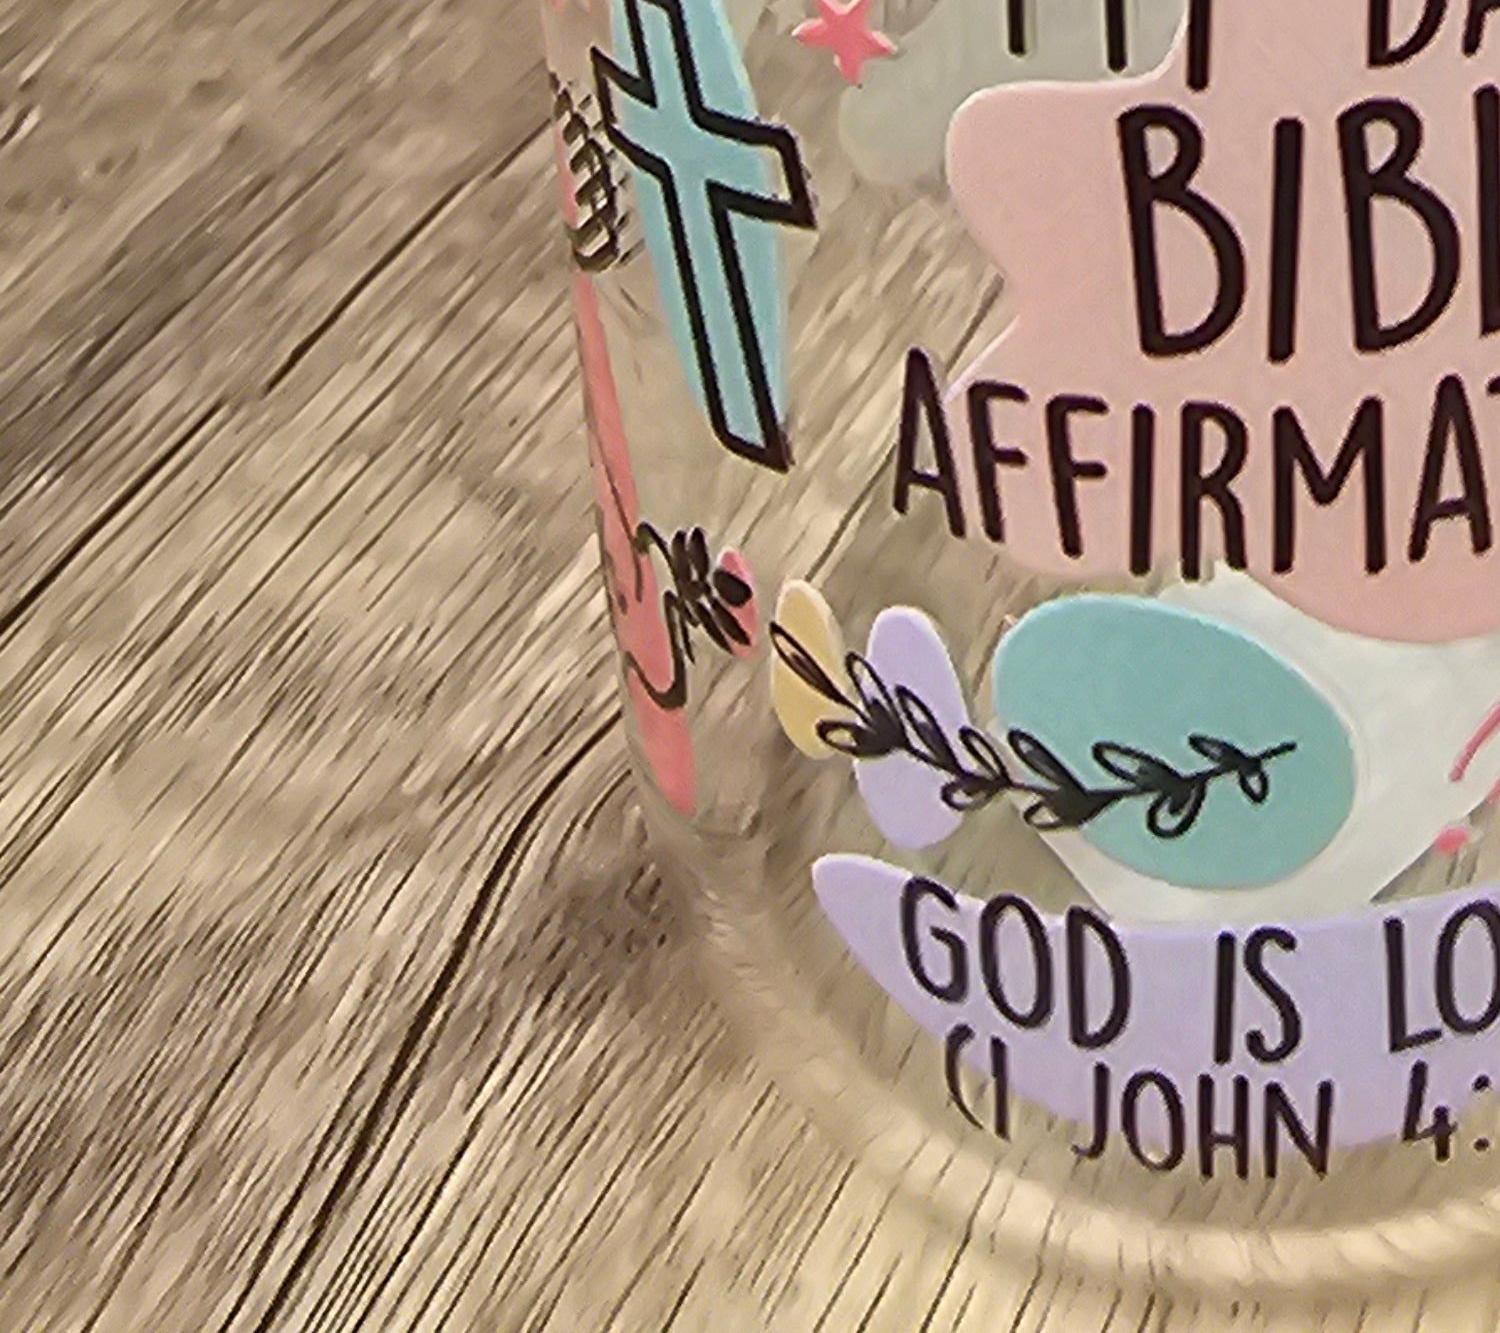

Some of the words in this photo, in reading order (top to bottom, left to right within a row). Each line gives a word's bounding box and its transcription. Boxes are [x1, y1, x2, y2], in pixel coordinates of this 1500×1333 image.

[899, 875, 1132, 1050] GOD
[1213, 927, 1303, 1066] IS
[943, 1021, 1010, 1143] (1
[1072, 1061, 1334, 1180] JOHN
